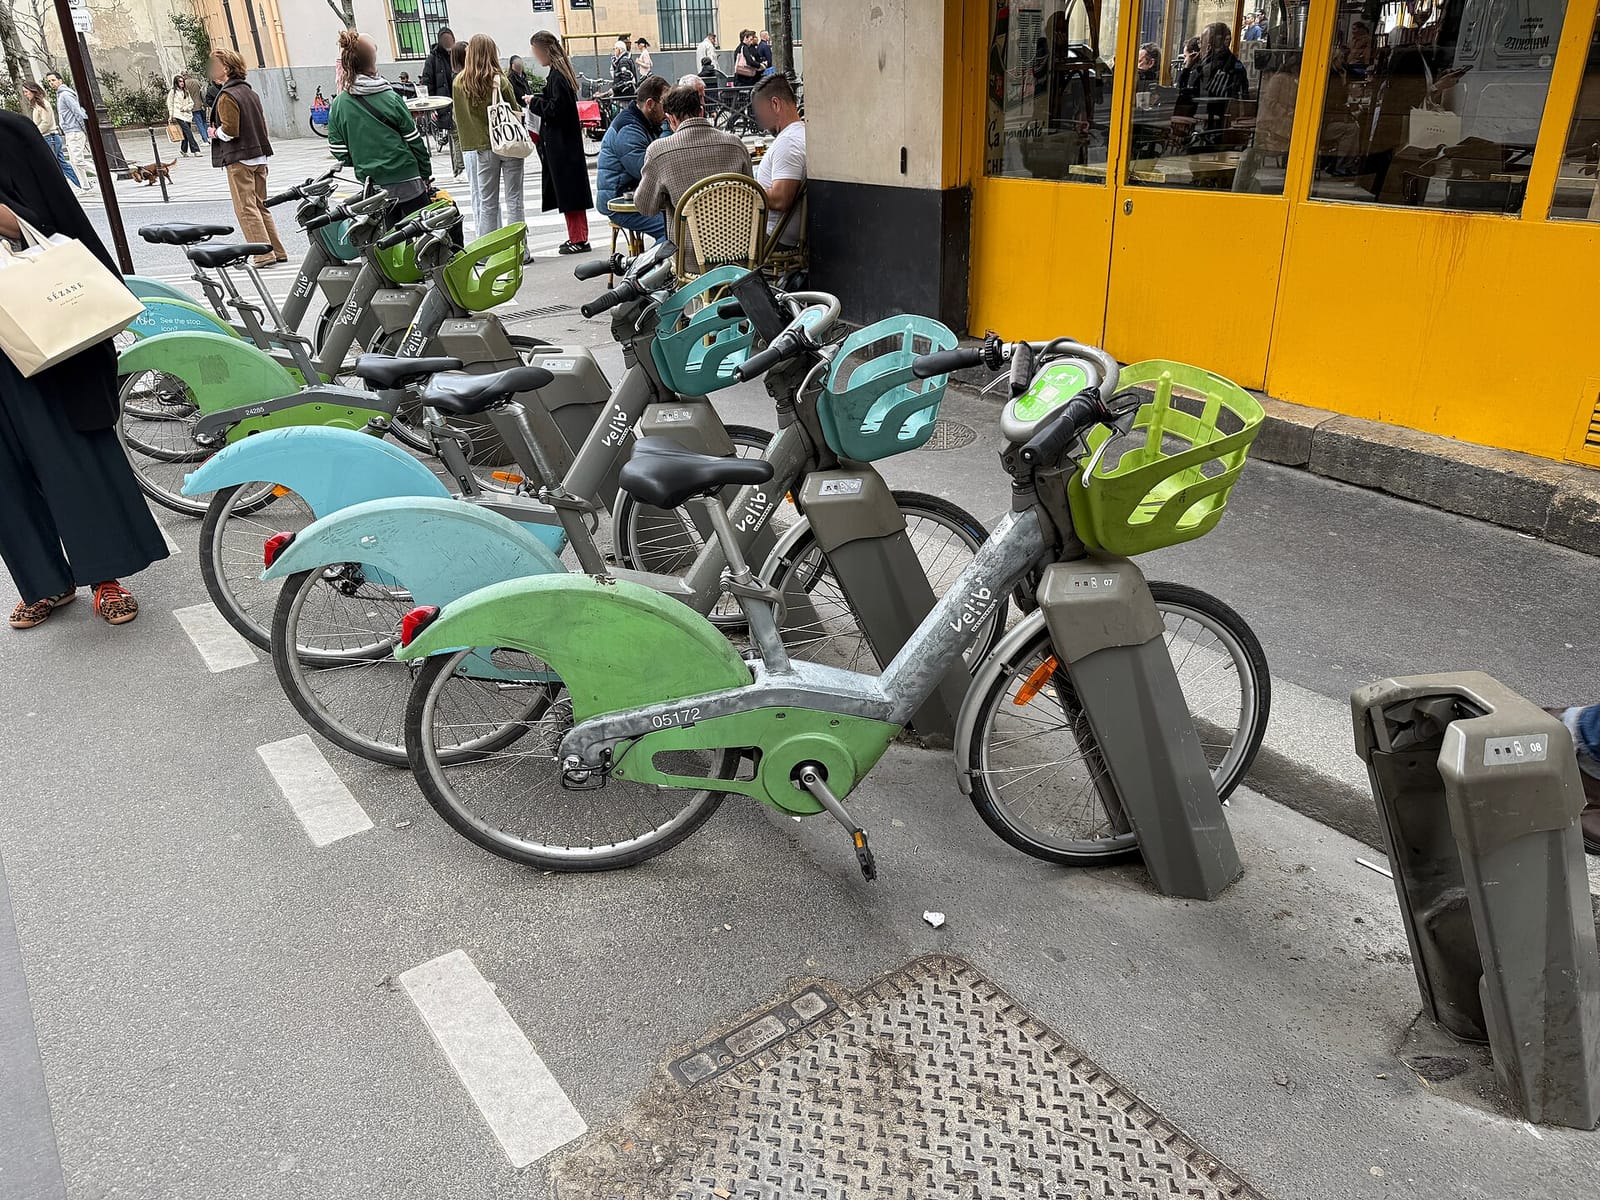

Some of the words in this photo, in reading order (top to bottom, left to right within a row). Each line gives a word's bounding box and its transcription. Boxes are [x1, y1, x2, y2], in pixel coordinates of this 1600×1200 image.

[1103, 579, 1113, 587] 07
[652, 707, 703, 728] 05172
[1530, 742, 1543, 753] 08
